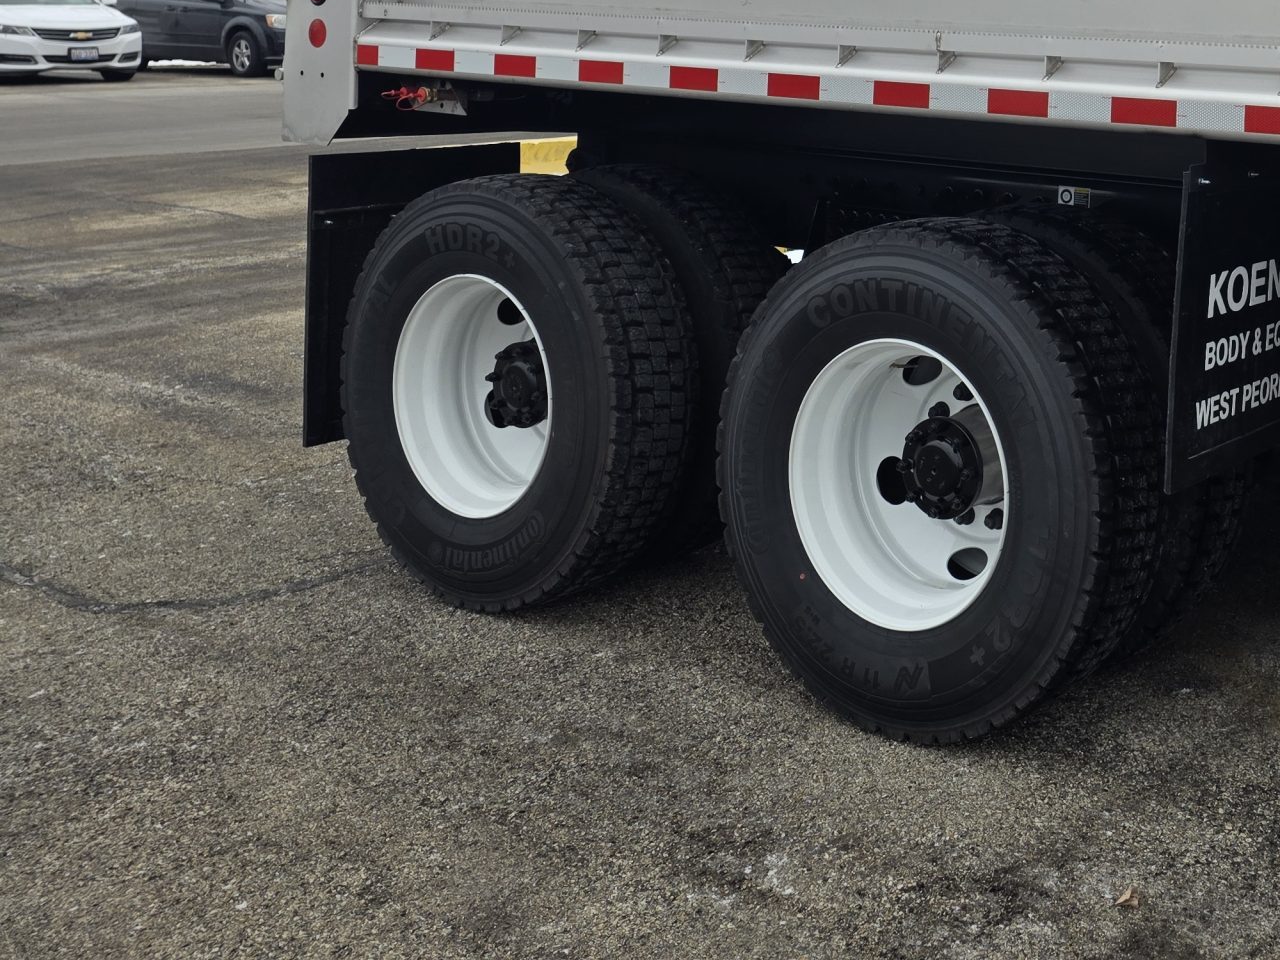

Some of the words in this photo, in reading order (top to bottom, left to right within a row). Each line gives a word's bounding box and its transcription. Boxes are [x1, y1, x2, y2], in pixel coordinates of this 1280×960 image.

[1204, 330, 1251, 371] BODY
[1252, 327, 1262, 356] &
[1195, 387, 1240, 430] WEST
